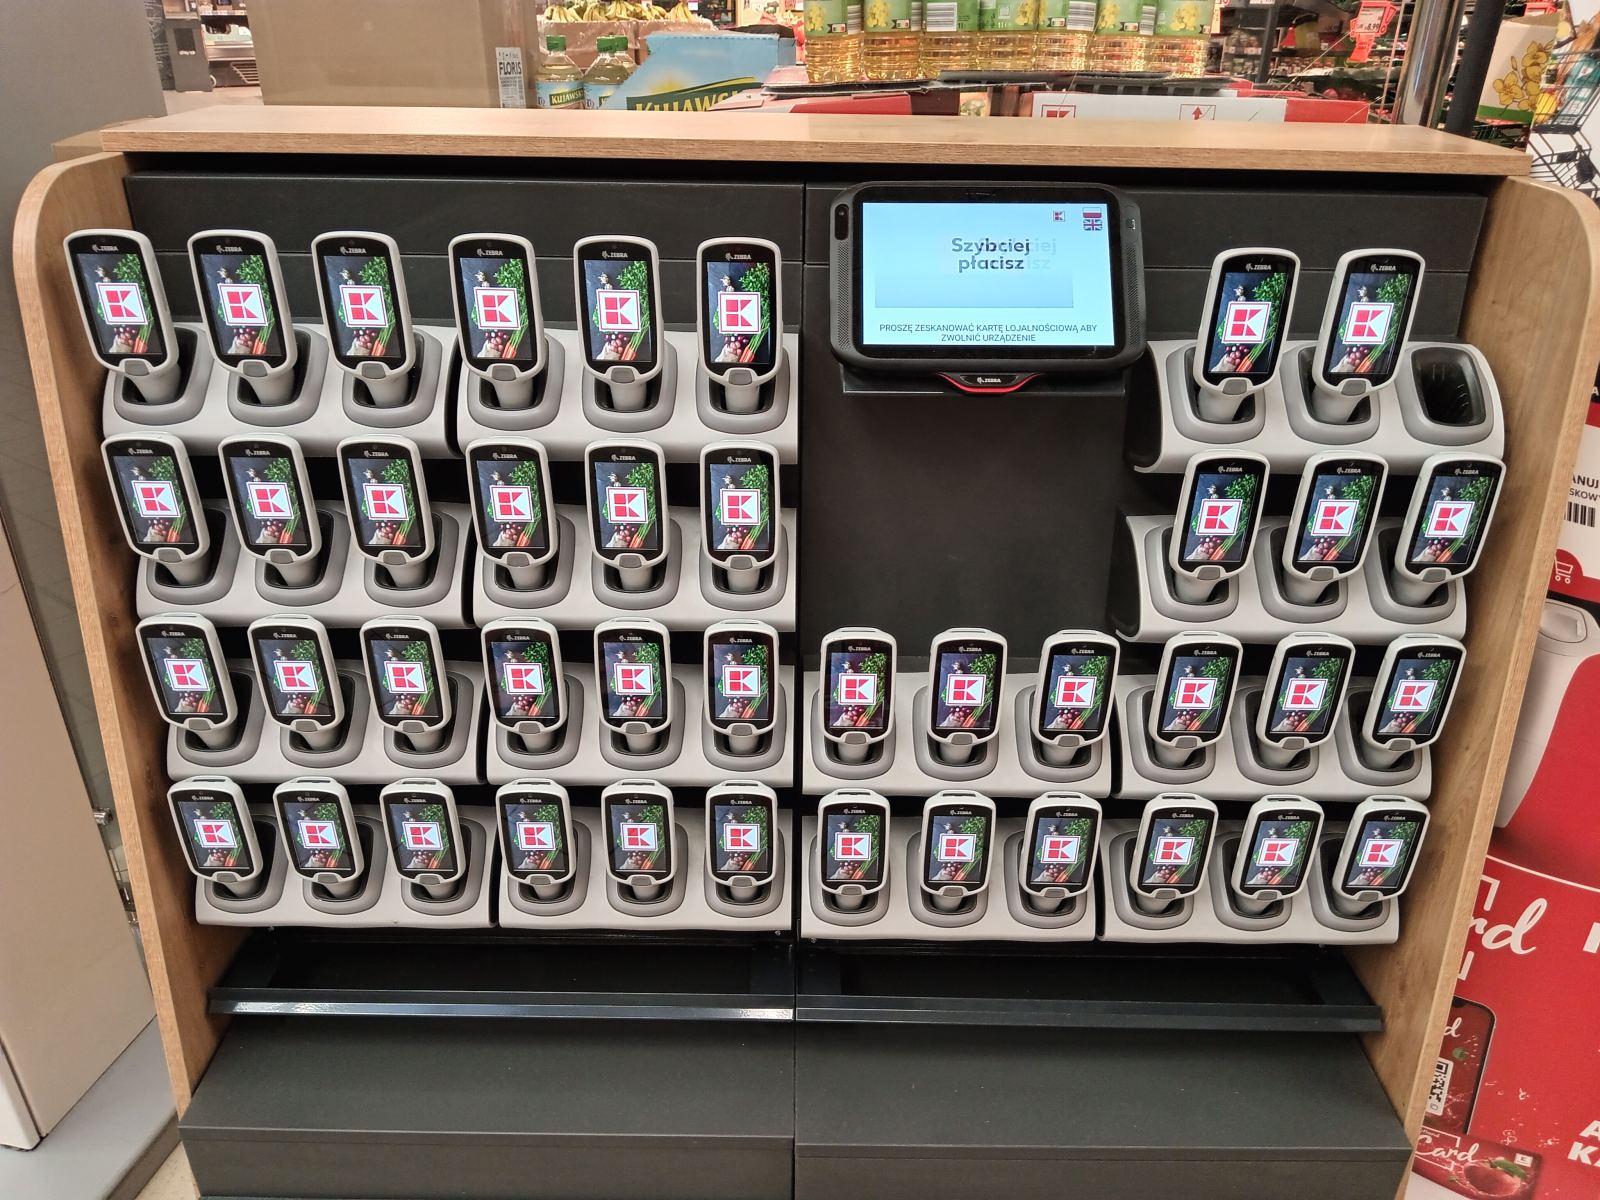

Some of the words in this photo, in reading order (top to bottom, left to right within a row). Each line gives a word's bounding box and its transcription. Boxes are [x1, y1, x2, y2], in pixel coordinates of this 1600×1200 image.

[498, 61, 522, 76] FLORIS
[951, 237, 1030, 255] Szybciej
[958, 255, 1025, 273] płacisz
[880, 324, 913, 333] PROSZĘ
[915, 323, 975, 332] ZESKANOWAĆ
[976, 324, 1004, 333] KARTĘ
[1005, 323, 1079, 333] LOJALNOŚCIOWĄ
[941, 333, 980, 342] ZWOLNIĆ
[982, 334, 1036, 343] URZĄDZENIE
